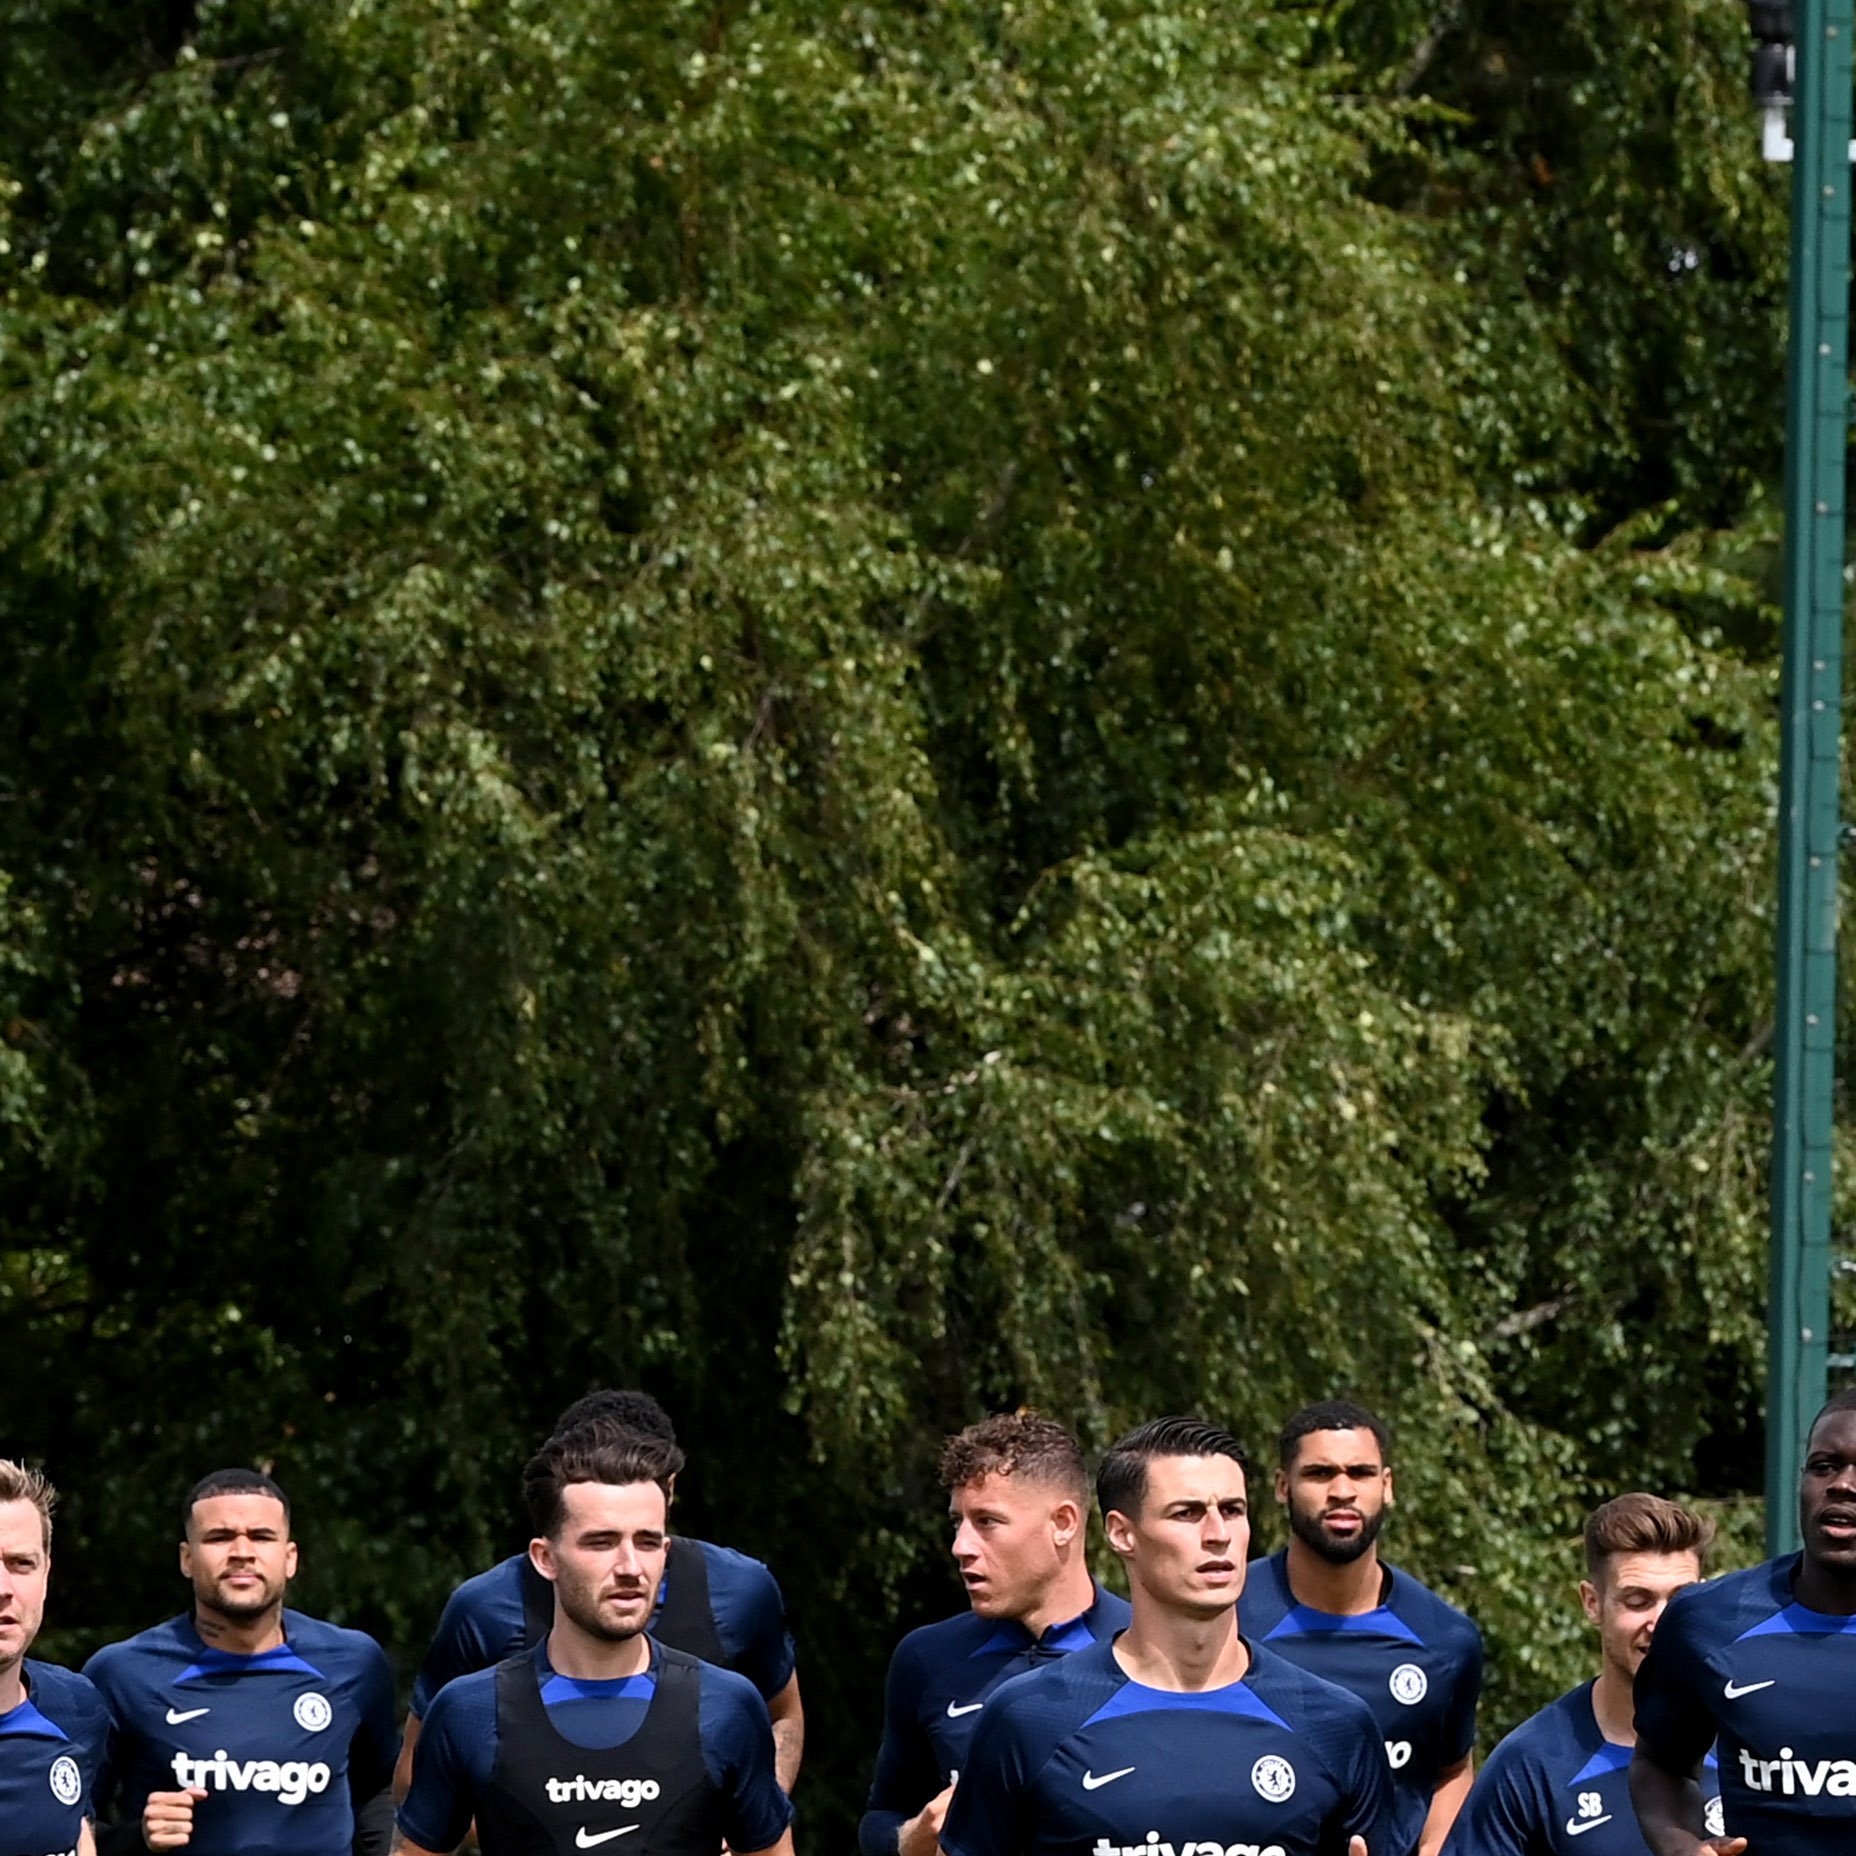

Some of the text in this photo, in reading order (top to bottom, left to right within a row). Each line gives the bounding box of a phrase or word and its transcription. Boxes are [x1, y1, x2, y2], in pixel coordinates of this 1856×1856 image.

[170, 1749, 331, 1805] trivago
[544, 1774, 661, 1808] trivago
[1577, 1791, 1603, 1818] SB
